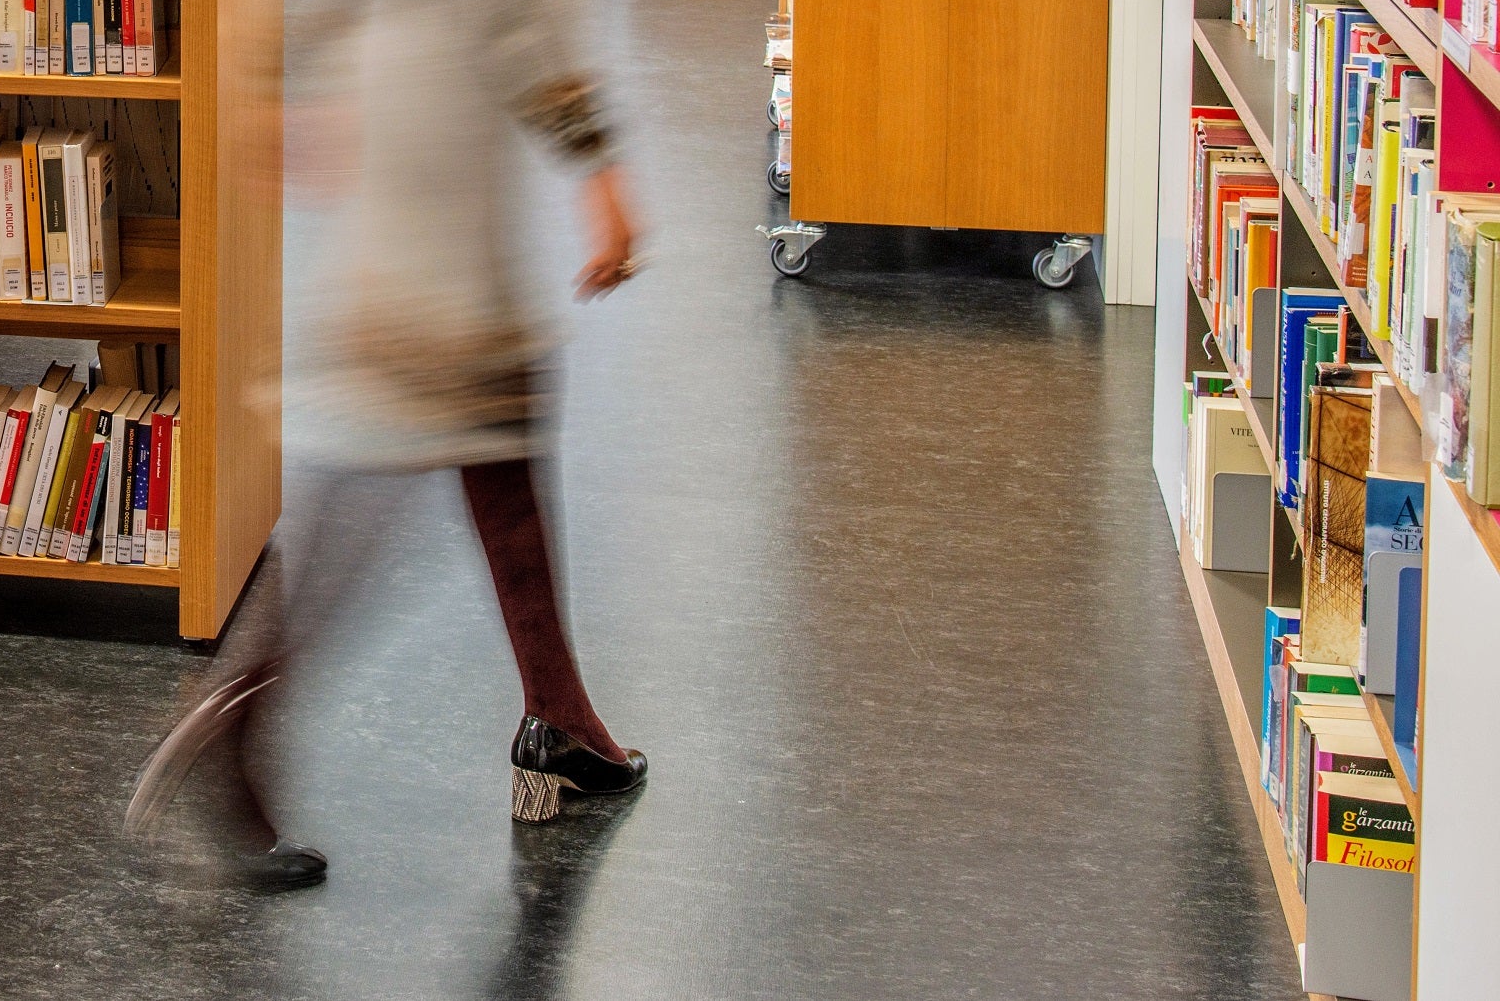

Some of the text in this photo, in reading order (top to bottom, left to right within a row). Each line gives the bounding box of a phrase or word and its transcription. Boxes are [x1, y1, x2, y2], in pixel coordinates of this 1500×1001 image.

[1230, 427, 1253, 437] VITE
[1359, 807, 1368, 816] le
[1342, 811, 1415, 832] garzanti
[1339, 840, 1414, 873] Filosof
